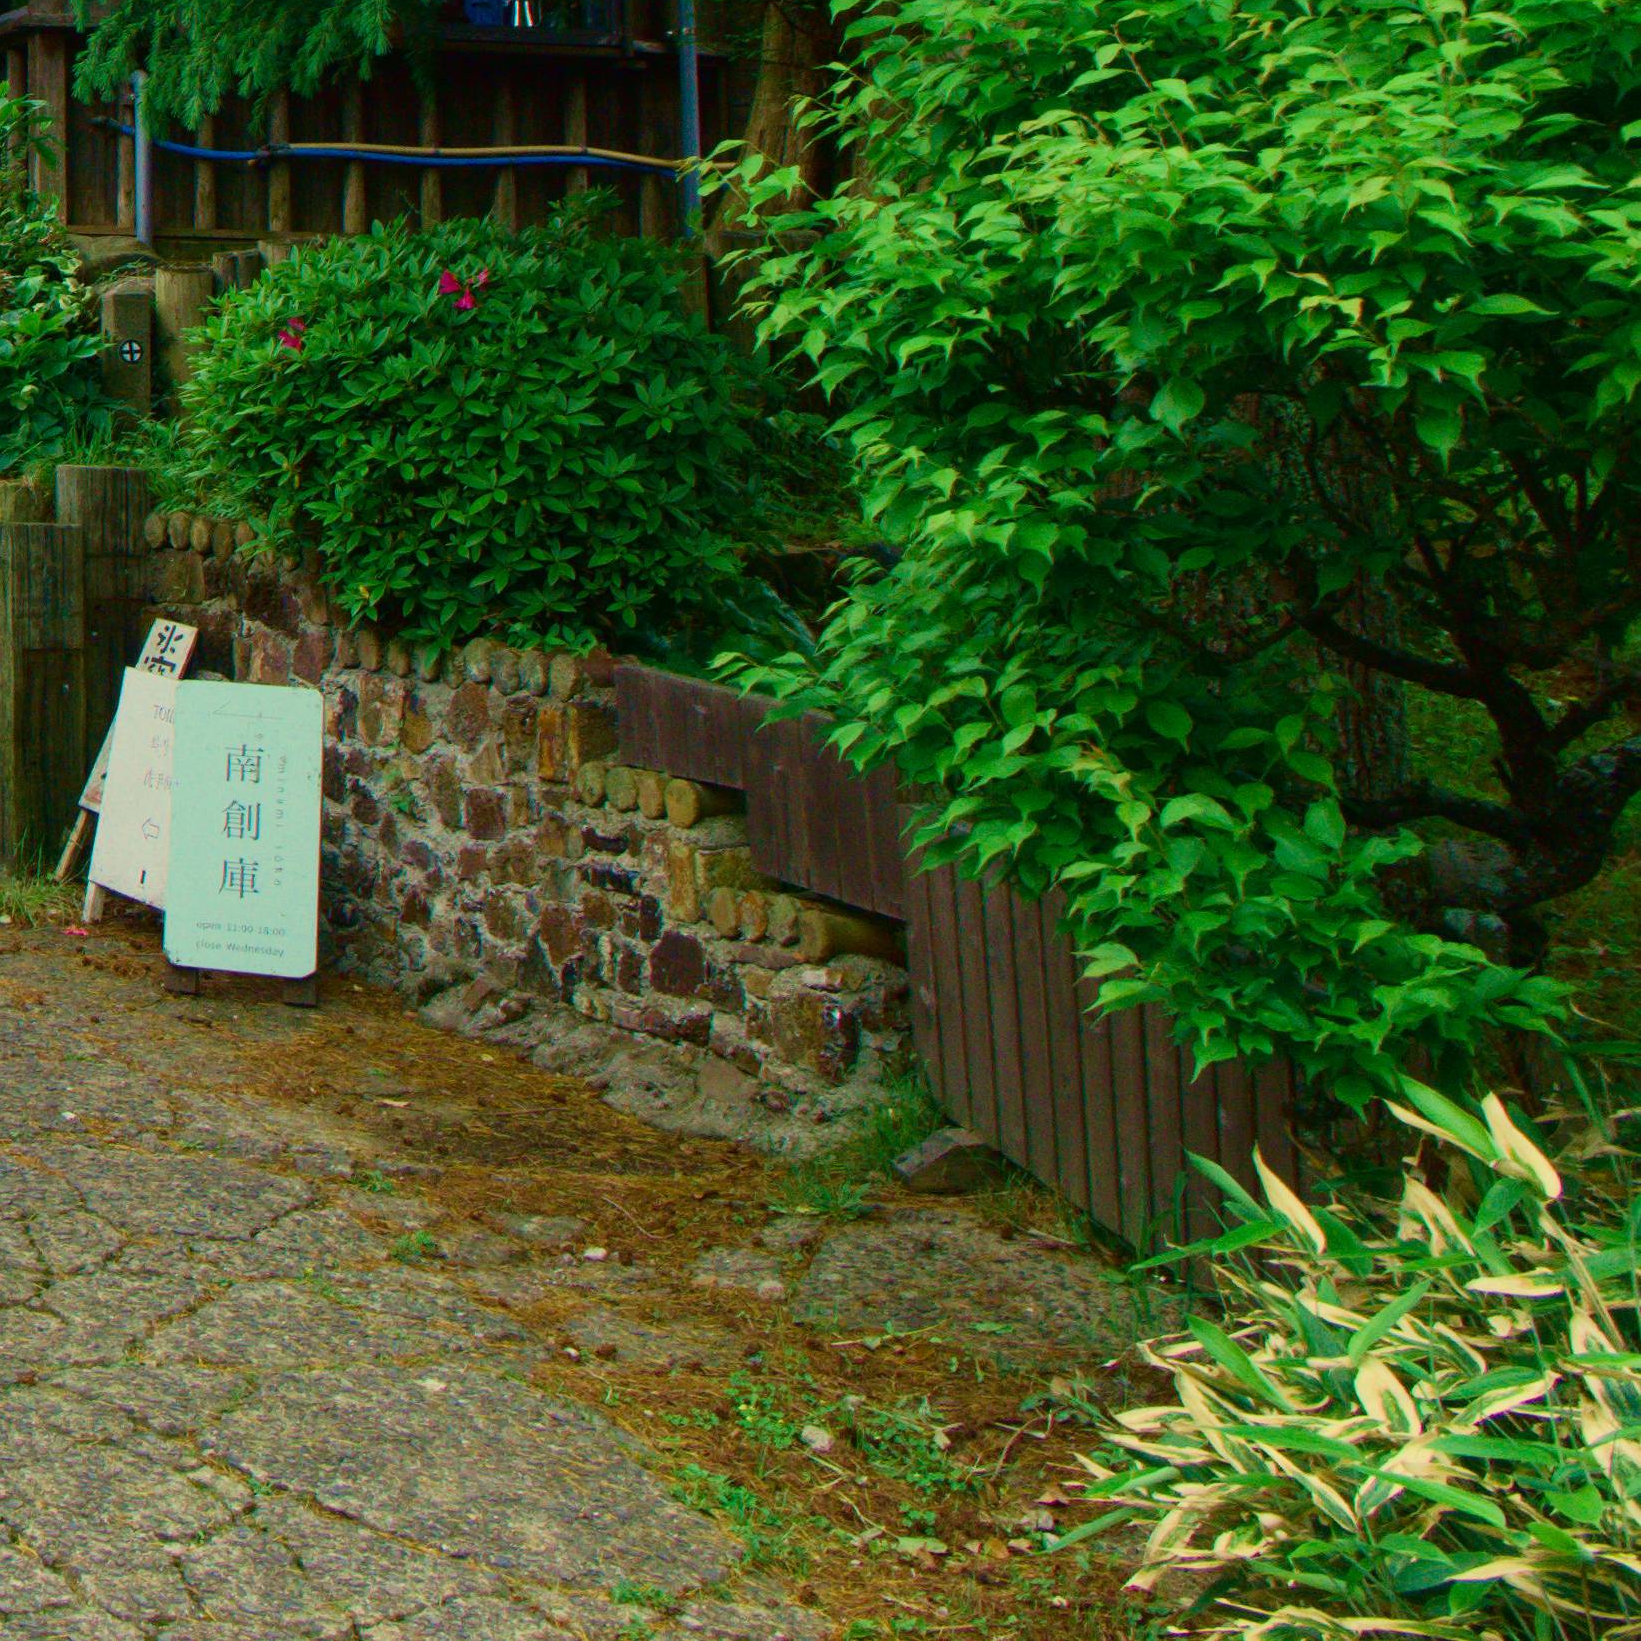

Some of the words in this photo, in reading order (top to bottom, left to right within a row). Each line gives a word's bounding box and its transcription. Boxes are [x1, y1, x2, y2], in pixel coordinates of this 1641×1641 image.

[219, 744, 264, 899] 南創庫
[196, 921, 222, 932] open
[196, 938, 222, 950] close
[227, 942, 284, 957] Wednesday
